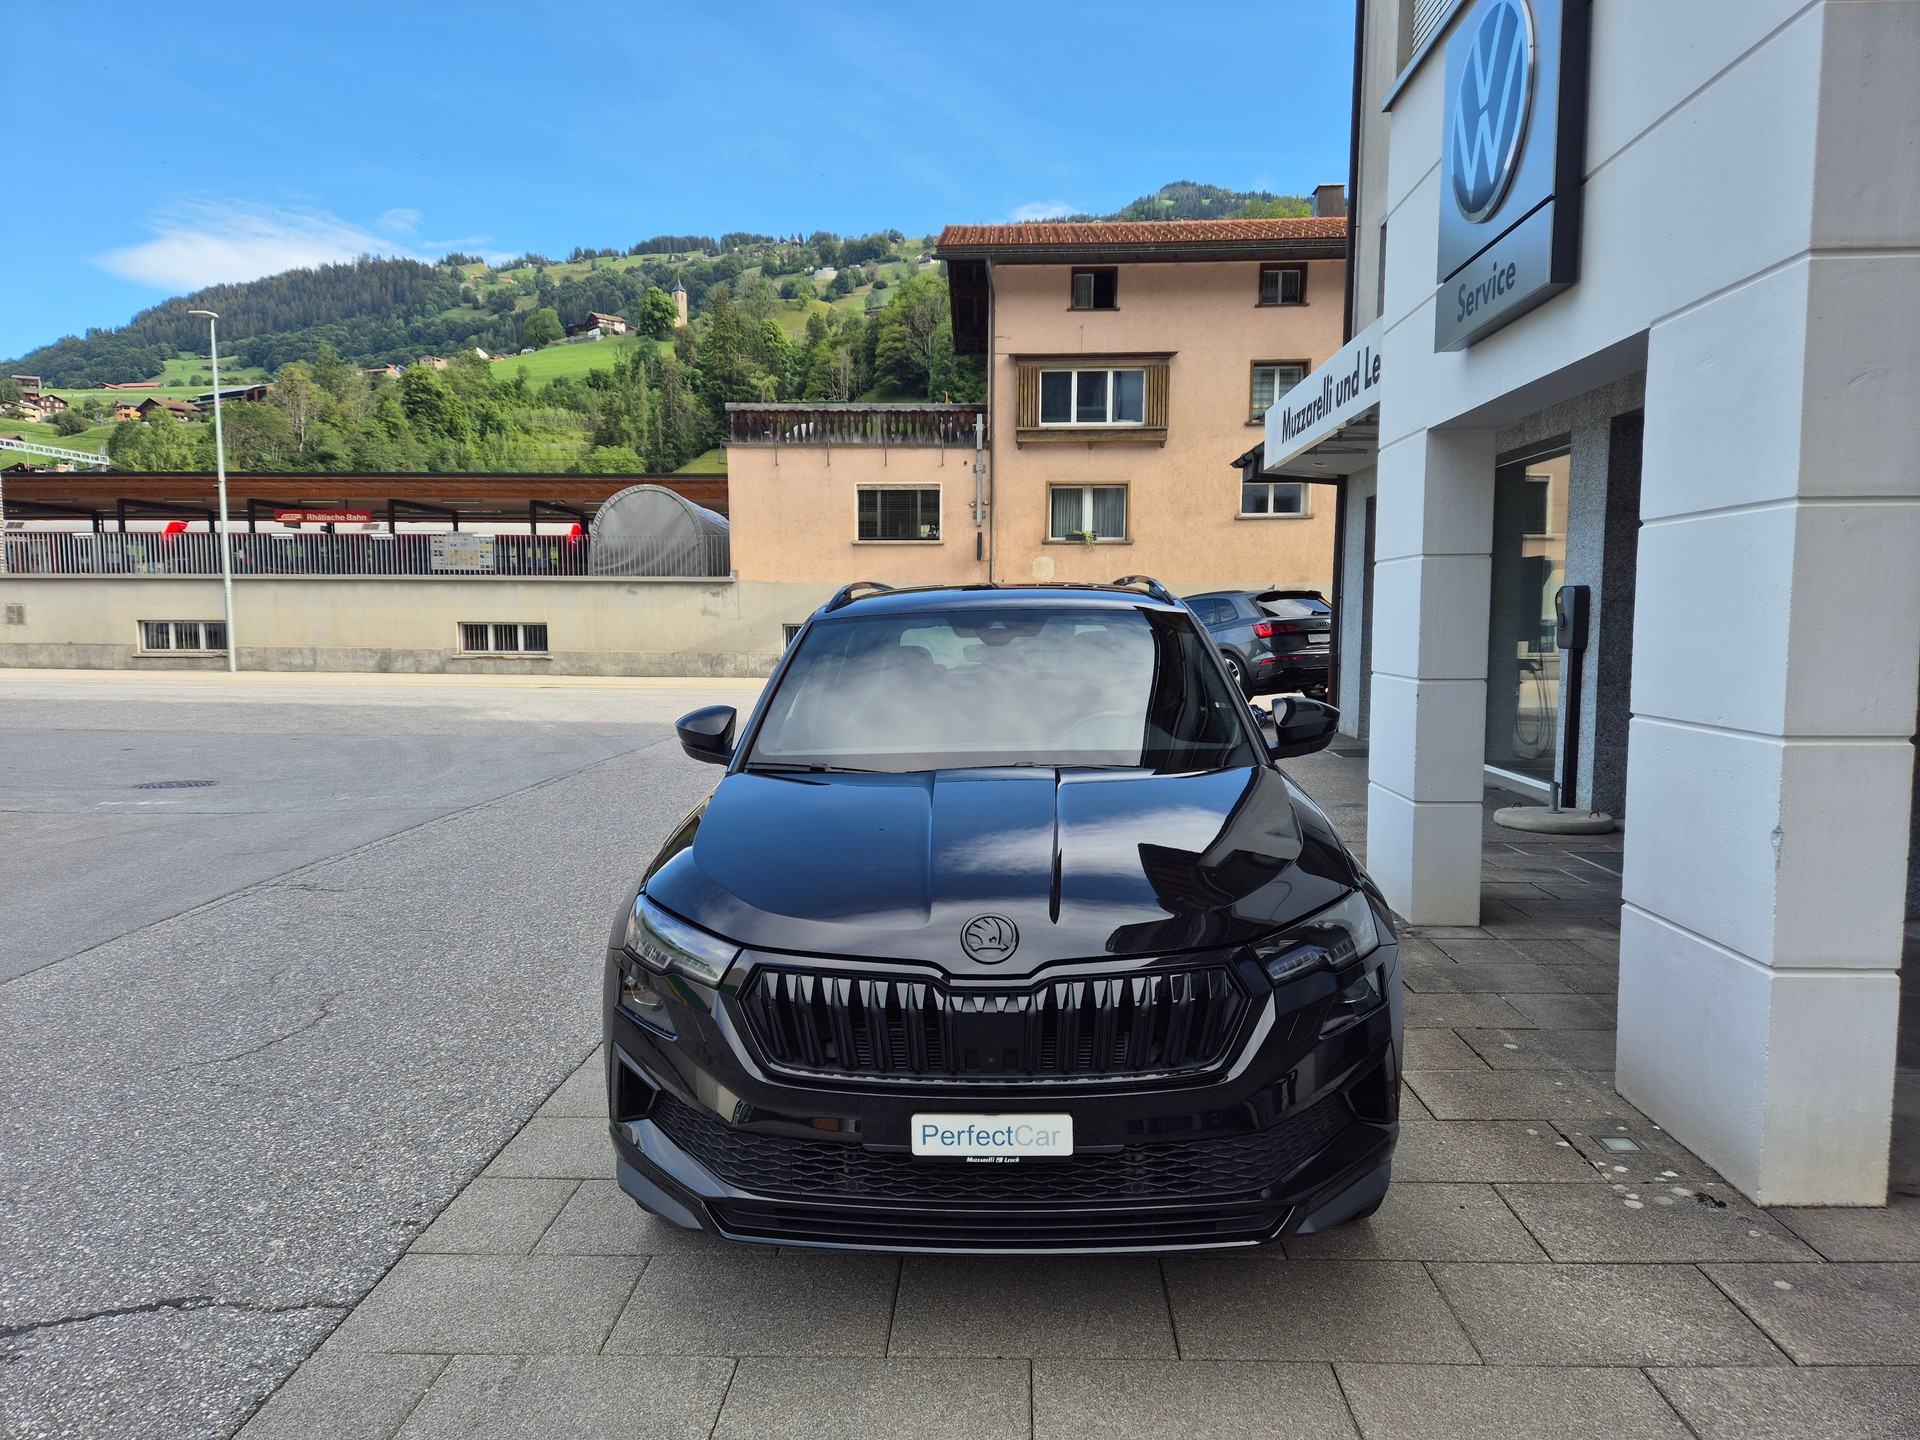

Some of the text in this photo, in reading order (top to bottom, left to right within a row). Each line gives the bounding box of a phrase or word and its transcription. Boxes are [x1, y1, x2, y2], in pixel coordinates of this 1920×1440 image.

[1457, 261, 1516, 323] Service
[1281, 374, 1333, 444] Muzzarelli
[1335, 350, 1361, 408] und
[306, 513, 367, 521] Rhätische Bahn
